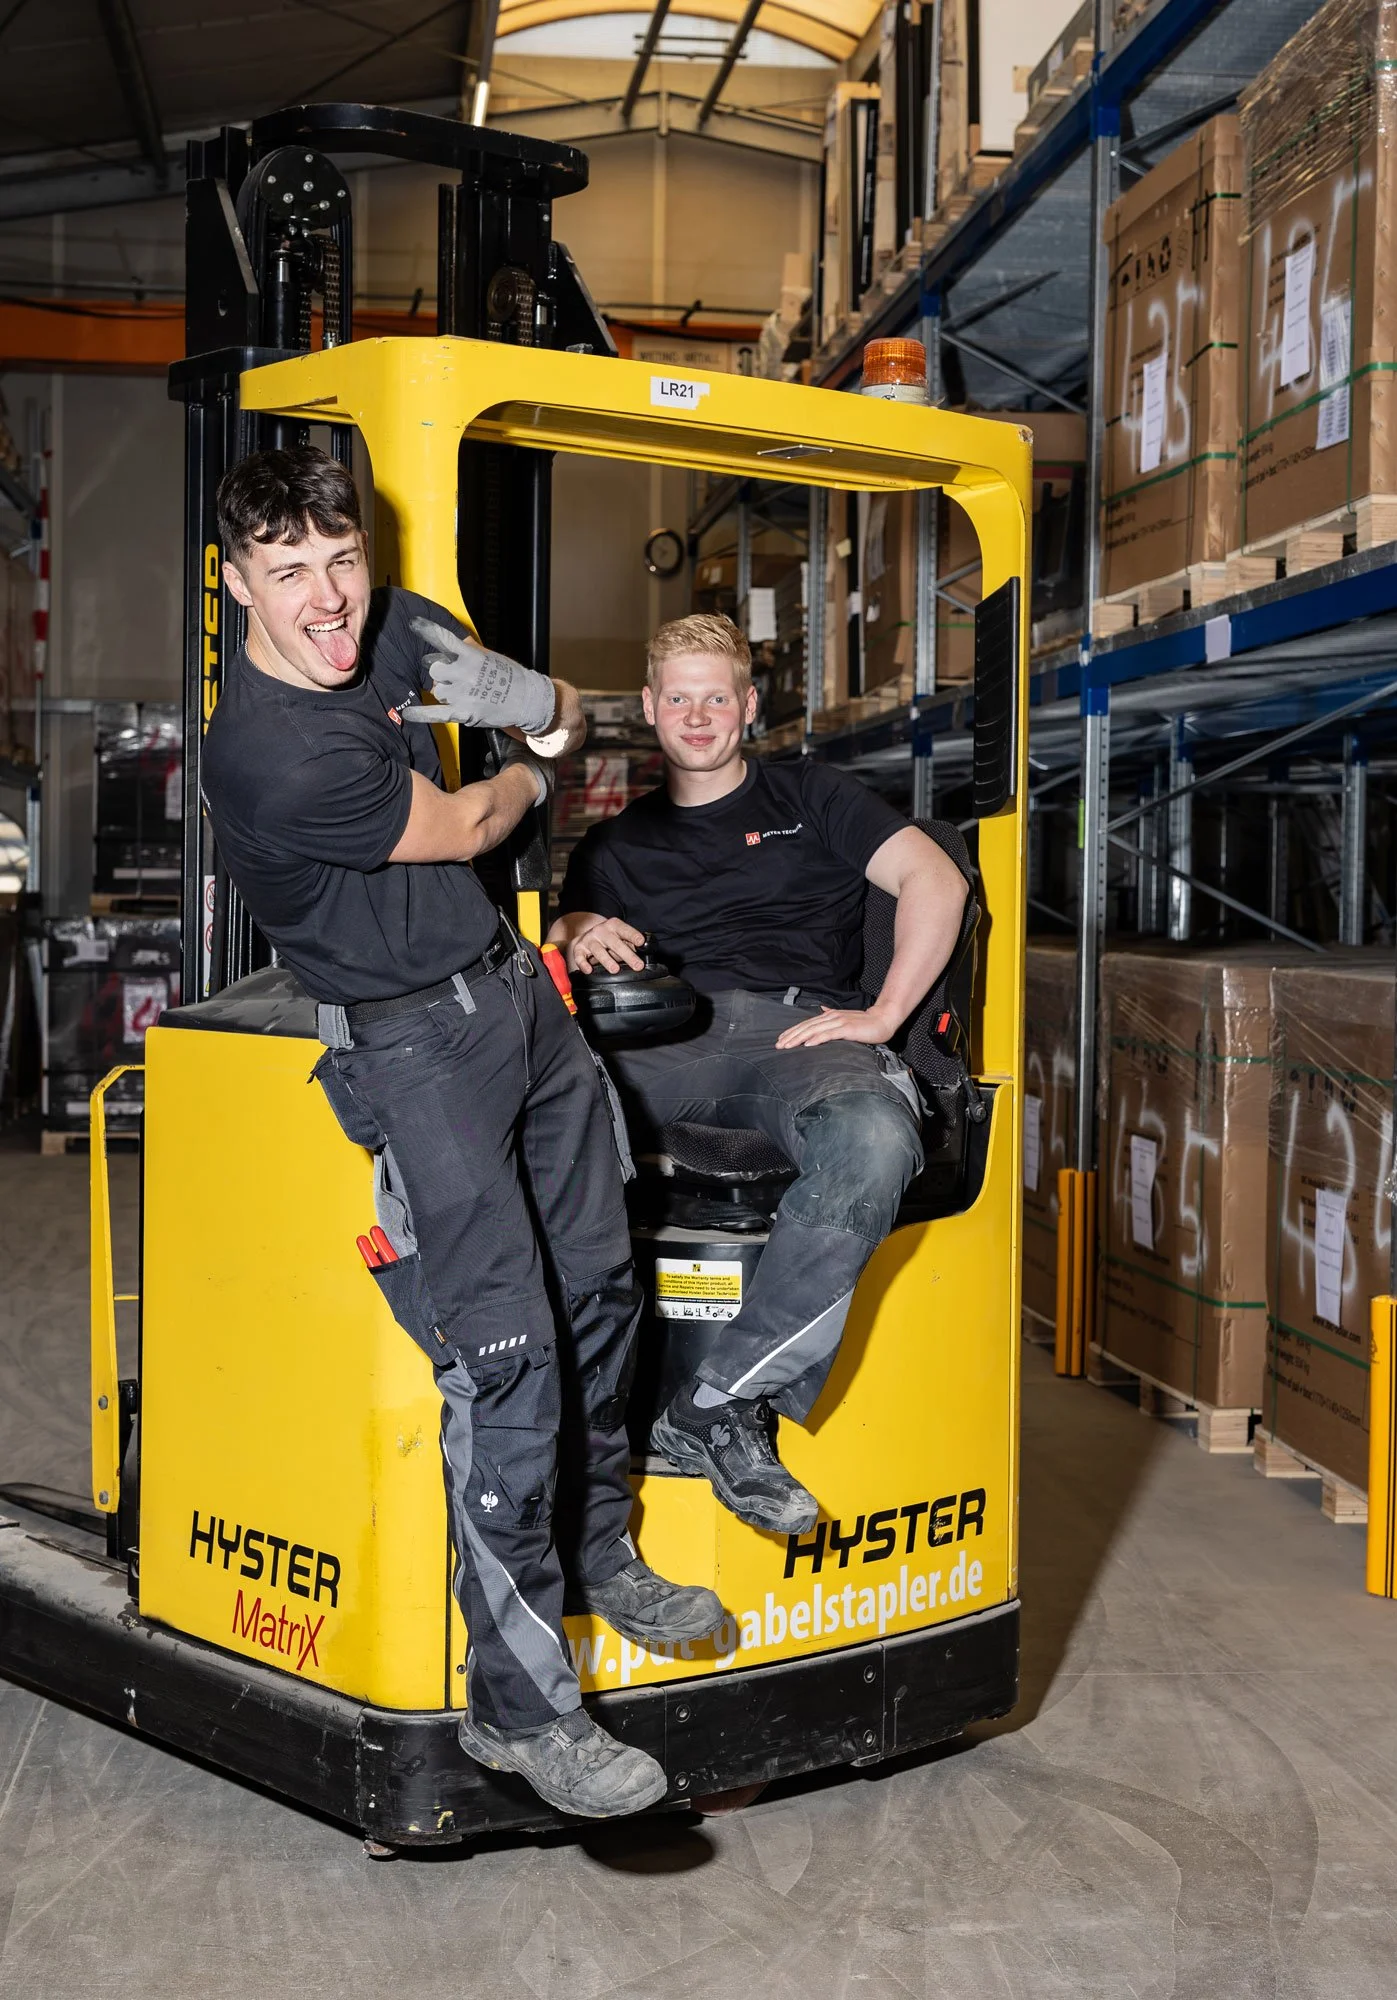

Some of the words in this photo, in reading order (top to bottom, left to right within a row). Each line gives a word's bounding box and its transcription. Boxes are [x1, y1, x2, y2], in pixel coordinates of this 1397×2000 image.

[661, 381, 694, 398] LR21
[189, 1510, 341, 1609] HYSTER
[783, 1488, 987, 1578] HYSTER
